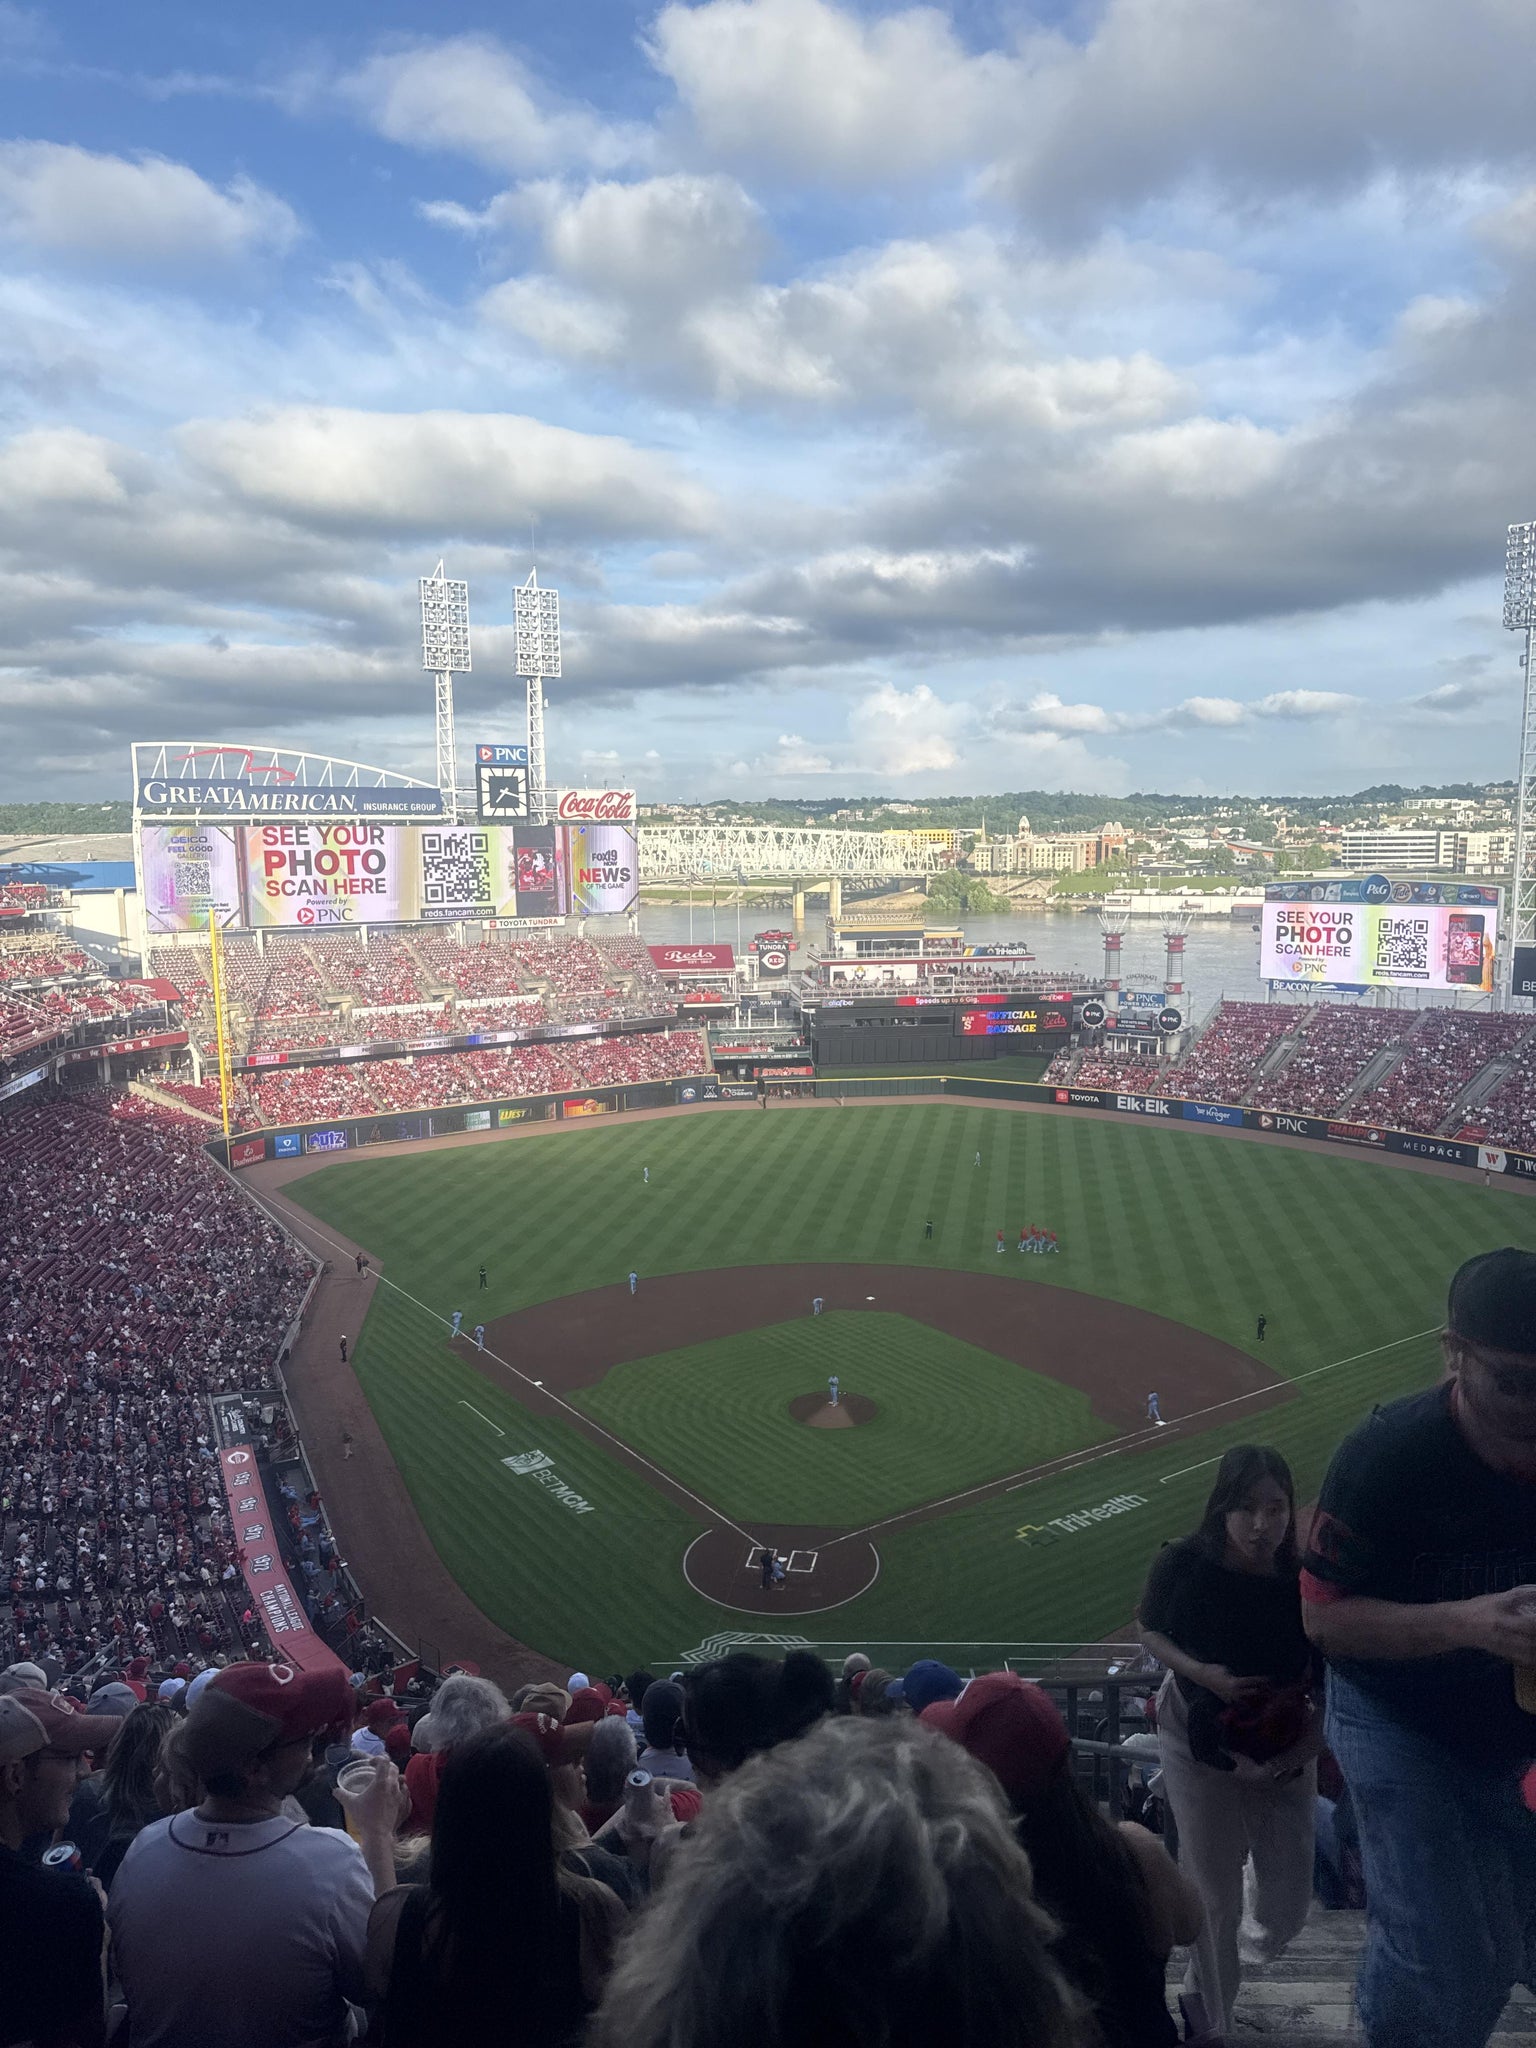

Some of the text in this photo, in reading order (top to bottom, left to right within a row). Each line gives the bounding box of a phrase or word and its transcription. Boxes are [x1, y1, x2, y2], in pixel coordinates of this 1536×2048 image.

[494, 747, 527, 762] PNC
[143, 781, 235, 804] GREAT
[363, 802, 408, 811] INSURANCE
[410, 802, 437, 811] GROUP
[558, 791, 634, 819] Coca-Cola
[170, 836, 208, 844] GEICO
[262, 825, 385, 846] SEE YOUR
[263, 848, 387, 877] PHOTO
[591, 849, 618, 862] FOX19
[578, 867, 631, 883] NEWS
[266, 877, 387, 897] SCAN HERE
[1366, 884, 1389, 895] P&G
[338, 898, 348, 906] by
[318, 908, 354, 922] PNC
[424, 908, 494, 918] reds.fancam.com
[1276, 910, 1353, 925] SEE YOUR
[499, 918, 558, 927] TOYOTA TUNDRA
[1275, 925, 1352, 944] PHOTO
[664, 949, 716, 962] Reds
[995, 947, 1026, 956] TriHealth
[1275, 943, 1351, 957] SCAN HERE
[1304, 963, 1327, 974] PNC
[1375, 970, 1428, 978] reds.fancam.com
[1272, 979, 1311, 992] BEACON
[915, 997, 940, 1005] Speeds
[1136, 994, 1157, 1003] PNC
[963, 1021, 972, 1030] S
[986, 1024, 1037, 1034] SAUSAGE
[1070, 1093, 1100, 1103] TOYOTA
[1206, 1106, 1231, 1122] Kroger
[1275, 1116, 1308, 1134] PNC
[1403, 1141, 1462, 1159] MEDPACE
[233, 1153, 265, 1167] Budweiser
[531, 1468, 595, 1515] BETMGM
[1047, 1493, 1149, 1533] TriHealth
[253, 1554, 271, 1573] 1972
[260, 1590, 289, 1633] CHAMPIONS
[274, 1583, 305, 1632] NATIONAL LEAGUE
